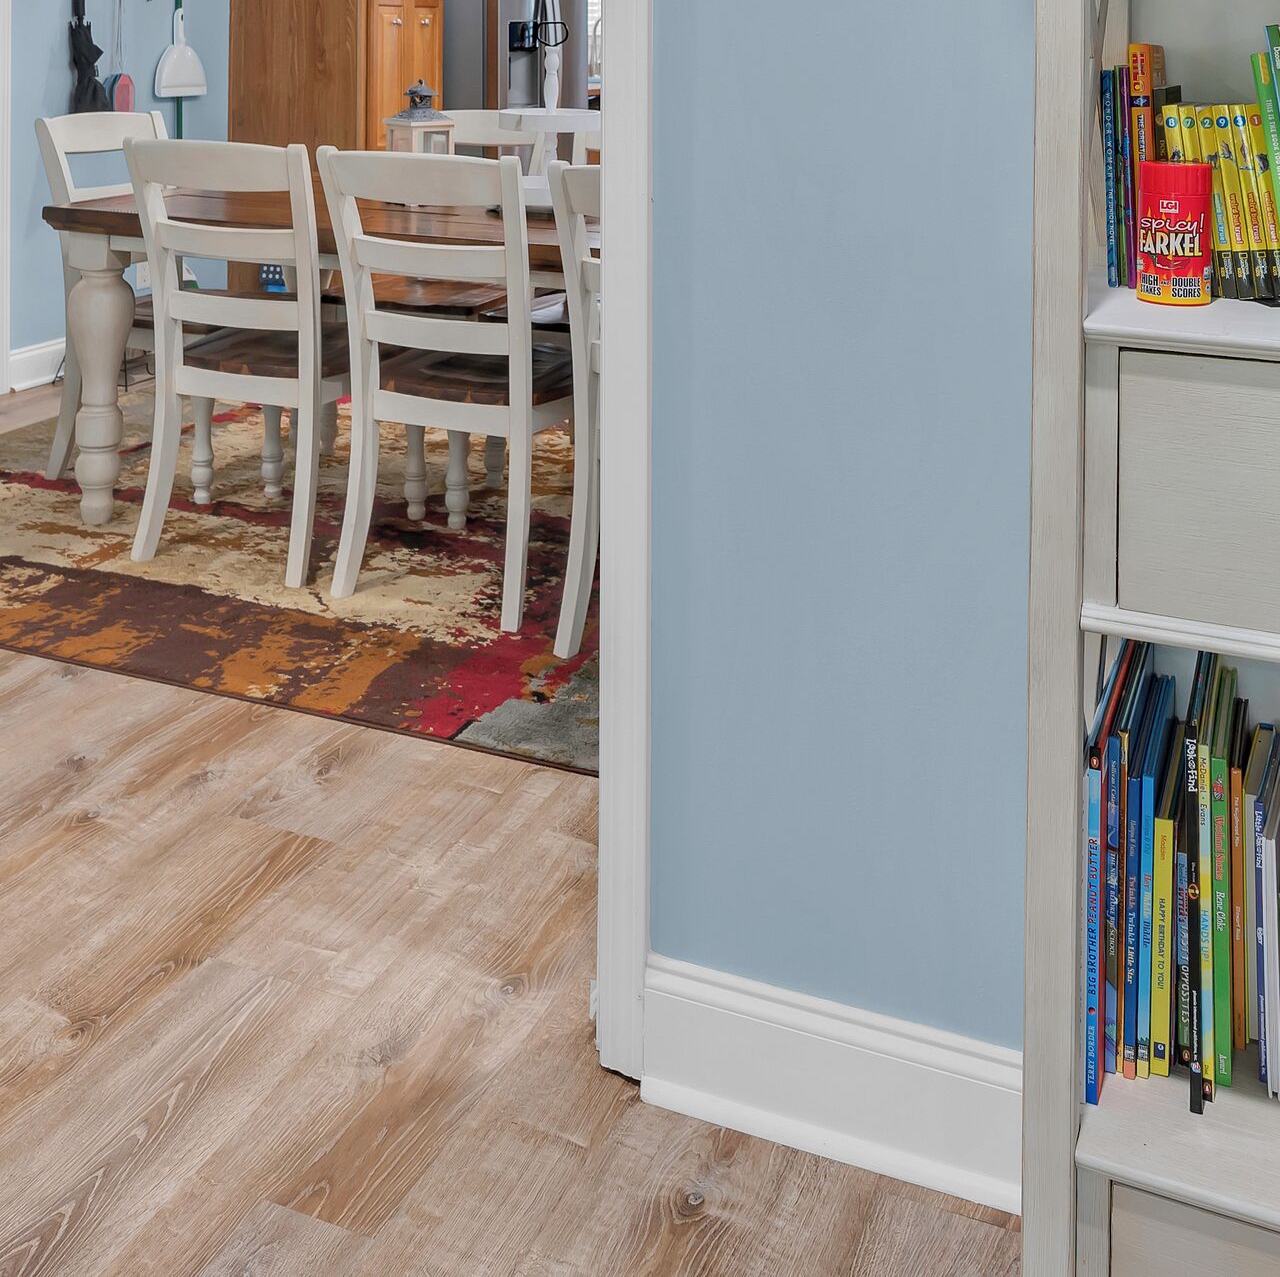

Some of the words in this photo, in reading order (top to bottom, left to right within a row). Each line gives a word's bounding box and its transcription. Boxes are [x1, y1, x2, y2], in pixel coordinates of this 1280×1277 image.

[1161, 201, 1178, 211] LGI
[1141, 213, 1204, 237] spicy!
[1140, 228, 1203, 257] FARKEL
[1140, 284, 1162, 296] STAKES
[1141, 273, 1159, 286] HIGH
[1172, 277, 1201, 287] DOUBLE
[1172, 287, 1201, 298] SCORES
[1199, 757, 1208, 794] McDaniel
[1199, 803, 1208, 826] Evans
[1089, 838, 1098, 880] BUTTER
[1088, 883, 1098, 925] PEANUT
[1158, 897, 1166, 923] HAPPY
[1215, 890, 1225, 911] Rene
[1127, 911, 1136, 945] Twinkle
[1200, 909, 1211, 944] HANDS
[1216, 911, 1226, 933] Cloke
[1088, 928, 1097, 974] BROTHER
[1157, 923, 1166, 961] BIRTHDAY
[1126, 945, 1135, 966] Little
[1201, 945, 1211, 963] UP!
[1126, 967, 1135, 985] Star
[1157, 962, 1165, 972] TO
[1088, 977, 1097, 995] BIG
[1157, 971, 1165, 991] YOU!
[1087, 1025, 1095, 1058] BORDER
[1086, 1058, 1094, 1085] TERRY
[1218, 1053, 1226, 1075] Award
